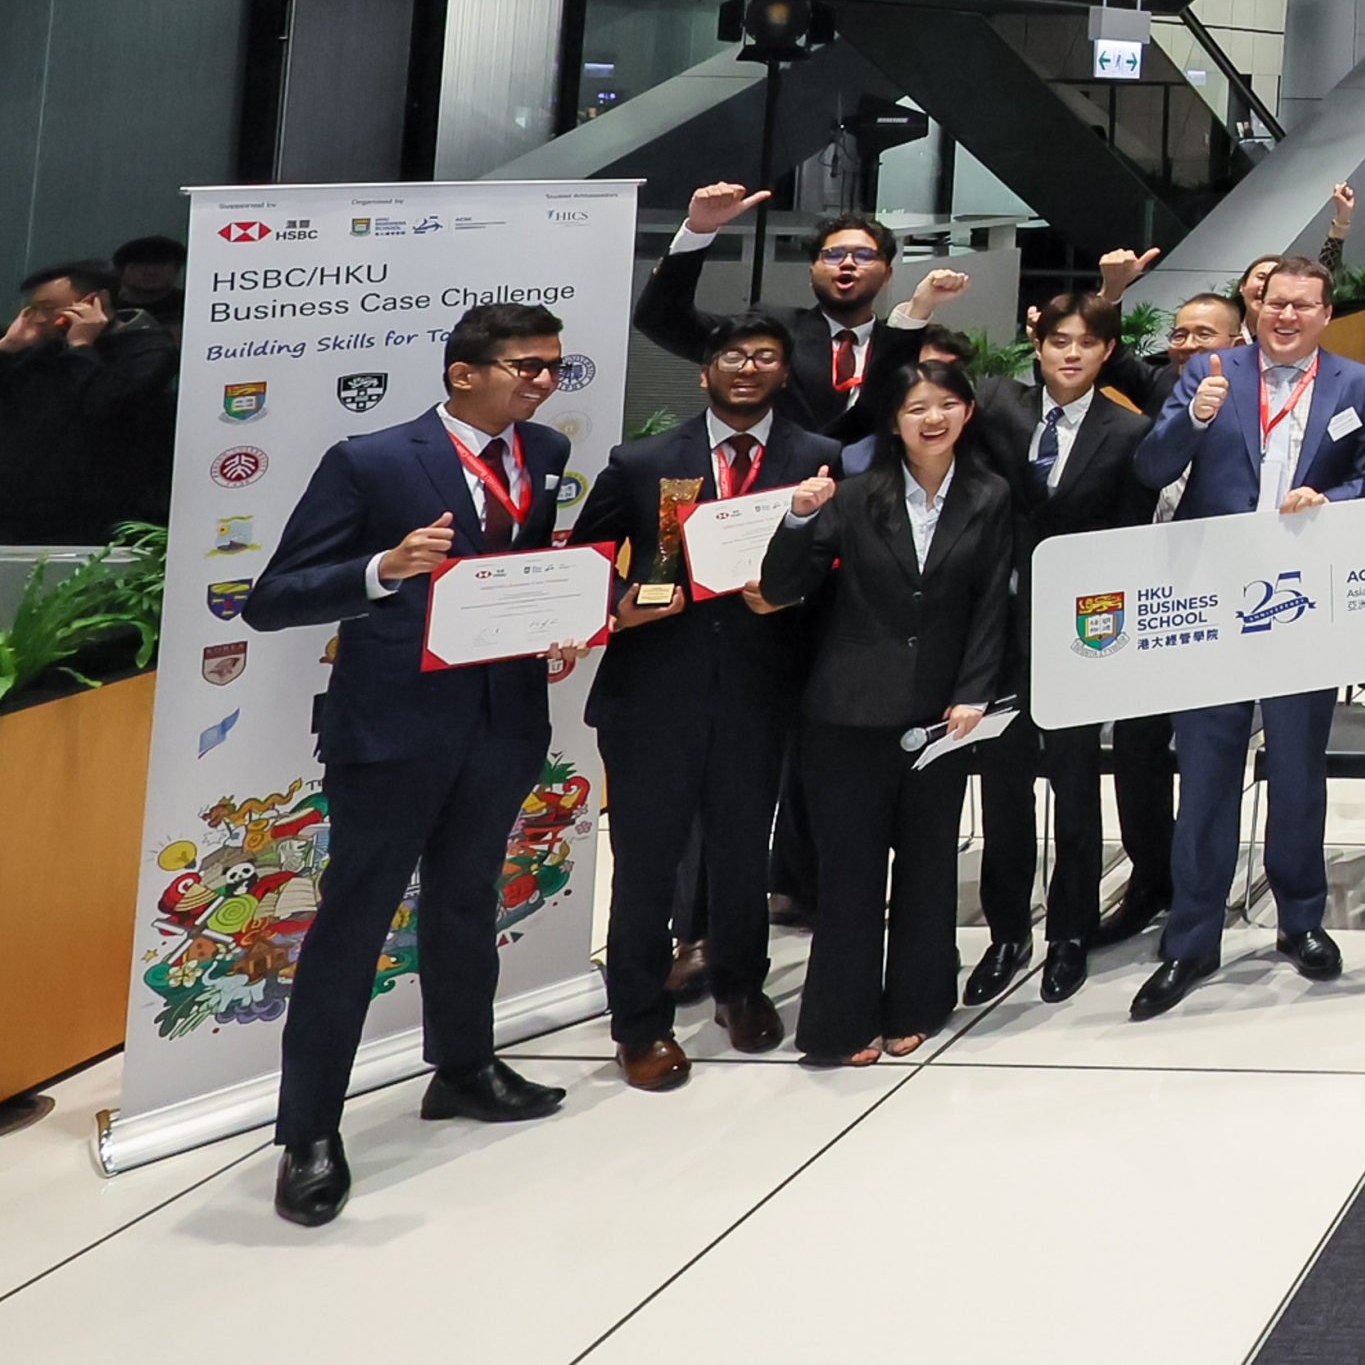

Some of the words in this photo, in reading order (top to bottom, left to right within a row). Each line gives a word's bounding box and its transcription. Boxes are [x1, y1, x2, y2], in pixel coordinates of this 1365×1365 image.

[275, 230, 319, 241] HSBC
[212, 263, 388, 293] HSBC/HKU
[210, 298, 349, 323] Business
[360, 293, 430, 313] Case
[441, 284, 575, 308] Challenge
[206, 339, 306, 361] Building
[316, 332, 375, 353] Skills
[384, 330, 418, 348] for
[1137, 585, 1173, 602] HKU
[1241, 571, 1305, 634] 25
[1137, 594, 1218, 617] BUSINESS
[1137, 611, 1208, 632] SCHOOL
[1137, 629, 1219, 651] 港大經管學院
